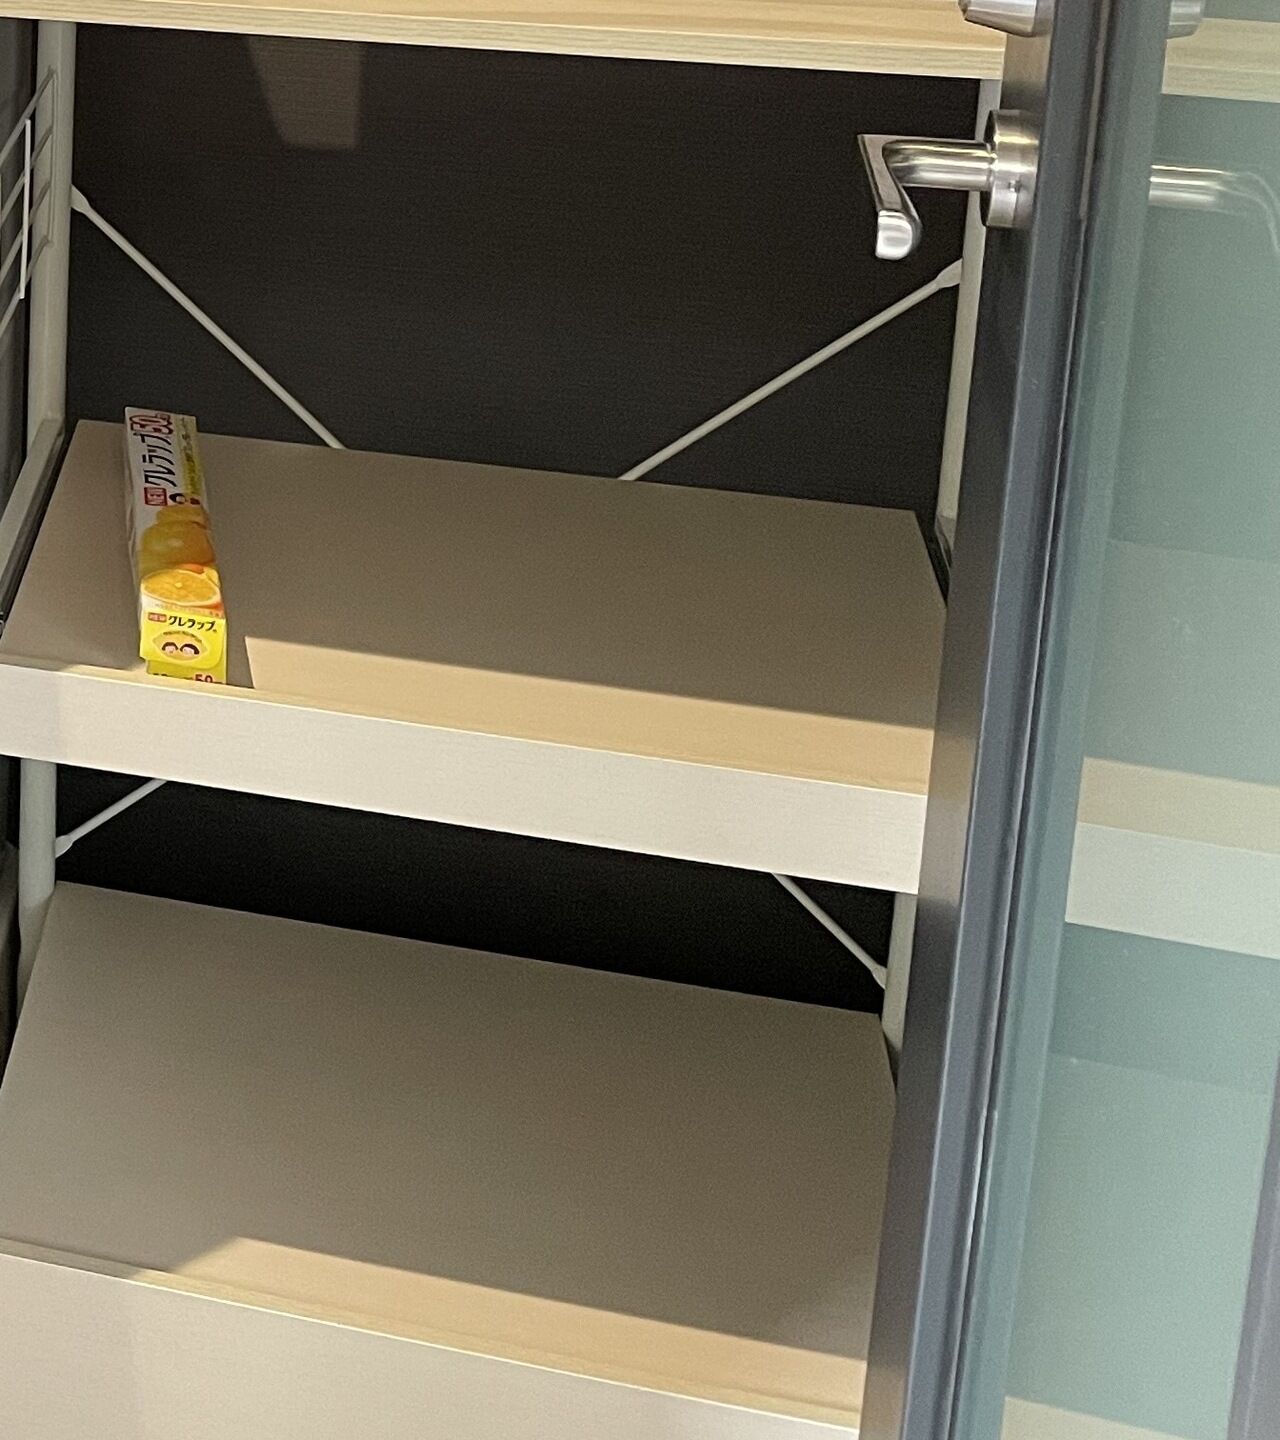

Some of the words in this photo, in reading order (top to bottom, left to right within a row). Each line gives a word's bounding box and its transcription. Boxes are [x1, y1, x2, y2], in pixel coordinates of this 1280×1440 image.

[133, 432, 177, 487] クレラップ
[168, 615, 215, 632] クレラップ
